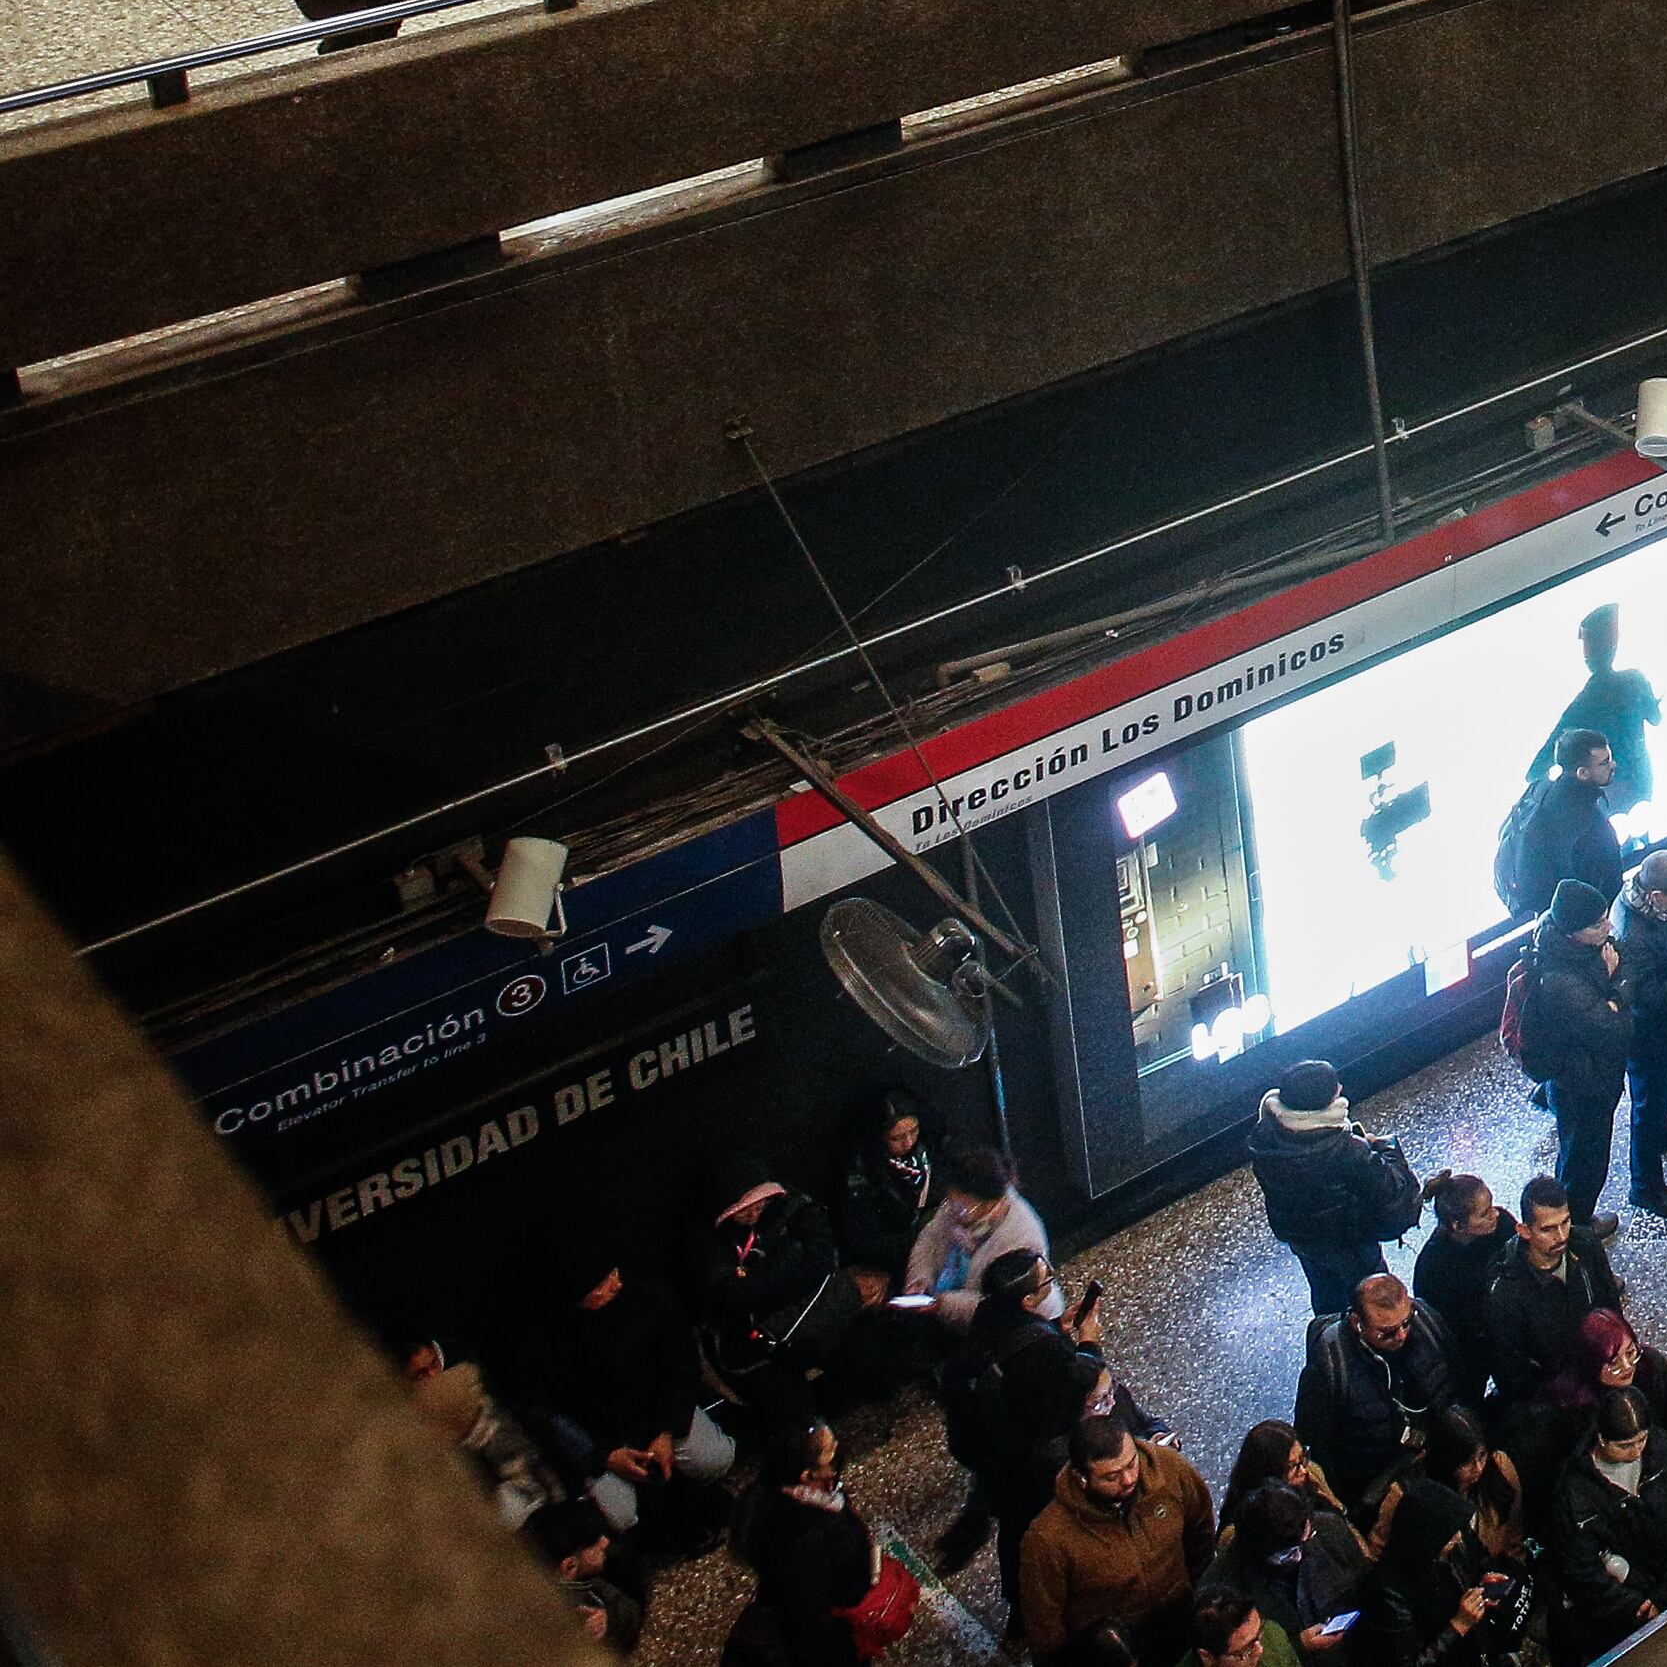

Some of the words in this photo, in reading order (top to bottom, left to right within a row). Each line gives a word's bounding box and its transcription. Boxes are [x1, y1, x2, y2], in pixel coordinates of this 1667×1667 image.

[911, 741, 1089, 835] Dirección
[1101, 713, 1160, 754] Los
[1173, 633, 1346, 723] Dominicos
[215, 1006, 487, 1134] Combinación
[277, 1095, 346, 1132] Elevator
[351, 1064, 419, 1097] Transfer
[423, 1054, 439, 1067] to
[443, 1040, 471, 1059] line
[286, 1105, 541, 1243] VERSIDAD
[554, 1068, 616, 1126] DE
[628, 1003, 757, 1091] CHILE
[1514, 1585, 1529, 1609] THE
